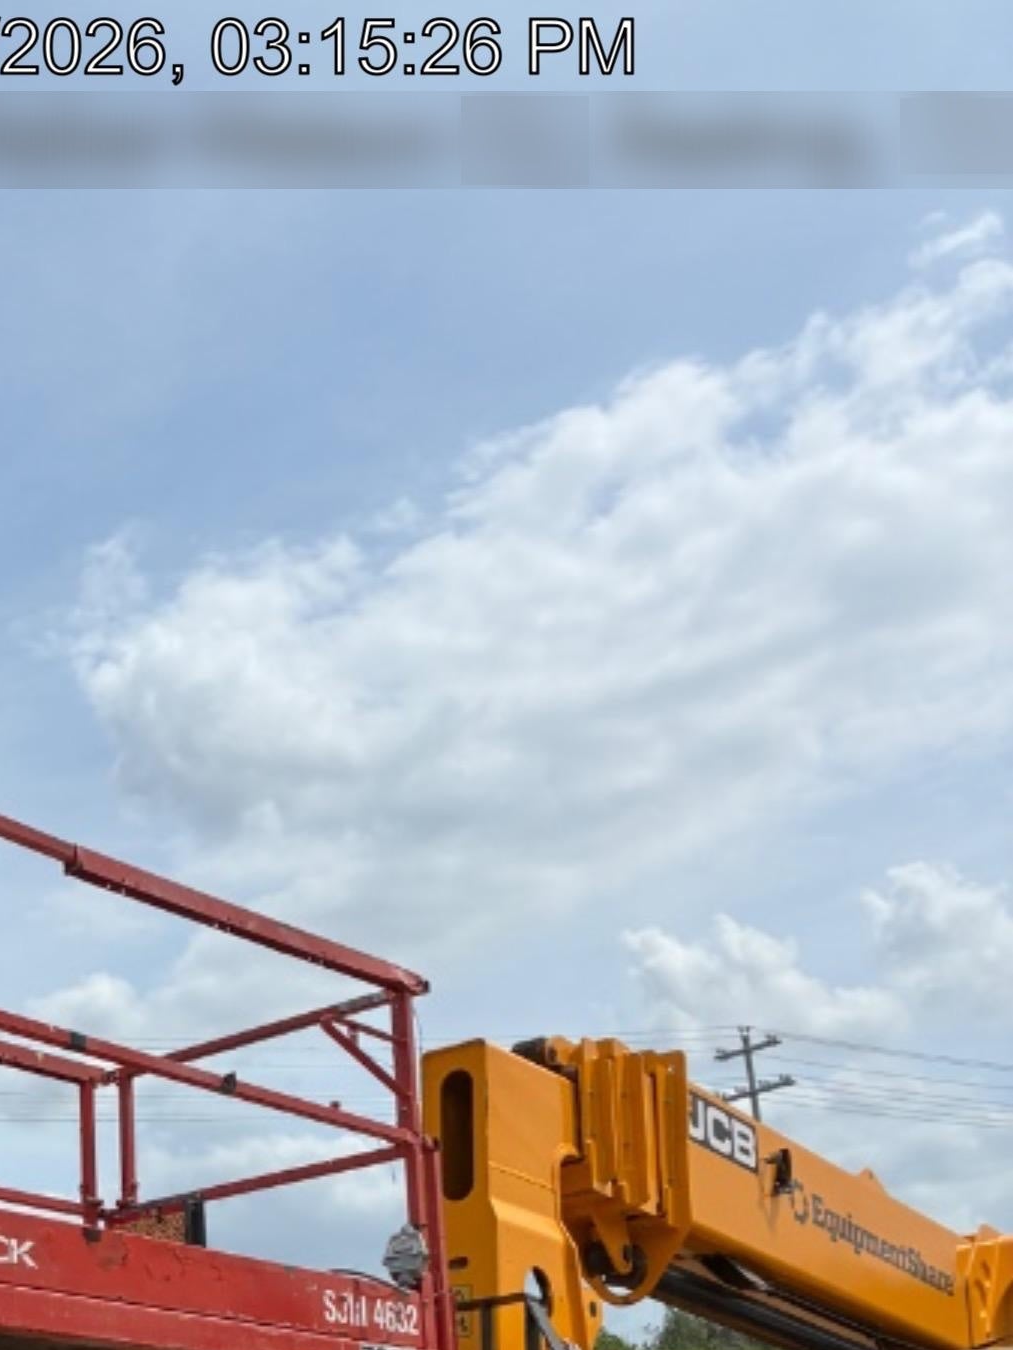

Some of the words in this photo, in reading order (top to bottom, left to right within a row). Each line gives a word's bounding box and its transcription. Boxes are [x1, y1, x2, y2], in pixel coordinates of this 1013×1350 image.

[689, 1099, 756, 1168] JCB
[811, 1193, 955, 1296] EquipmentShare
[373, 1298, 419, 1336] 4632
